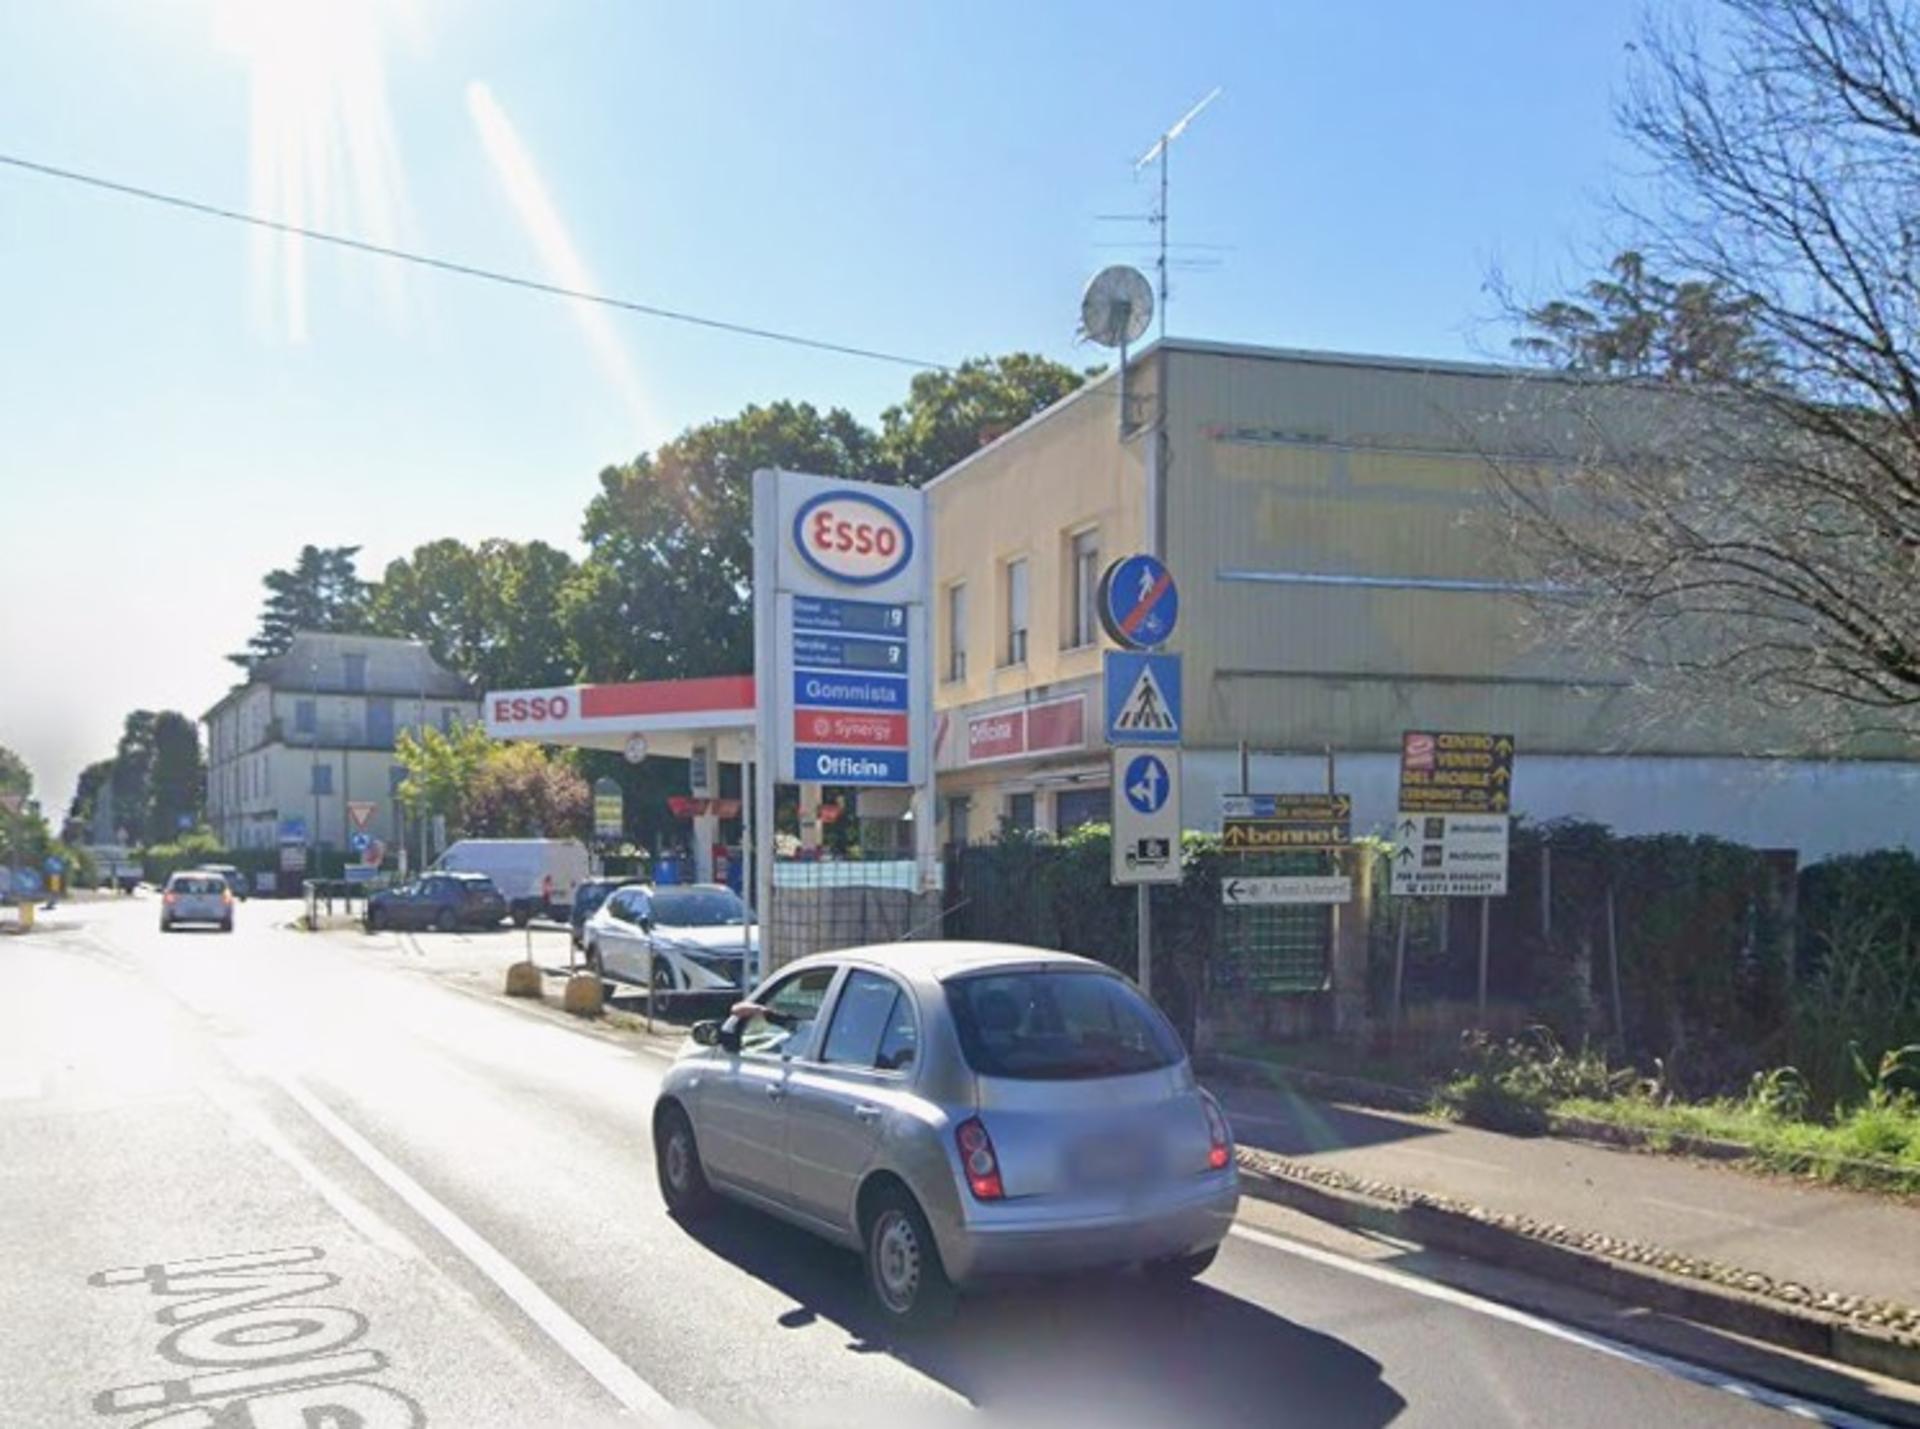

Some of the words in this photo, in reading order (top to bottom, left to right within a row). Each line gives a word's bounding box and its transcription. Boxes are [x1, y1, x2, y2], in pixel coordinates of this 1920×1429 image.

[806, 680, 898, 703] Gommista
[834, 717, 893, 742] Synergy
[1438, 734, 1494, 750] CENTRO
[816, 754, 889, 777] Officina
